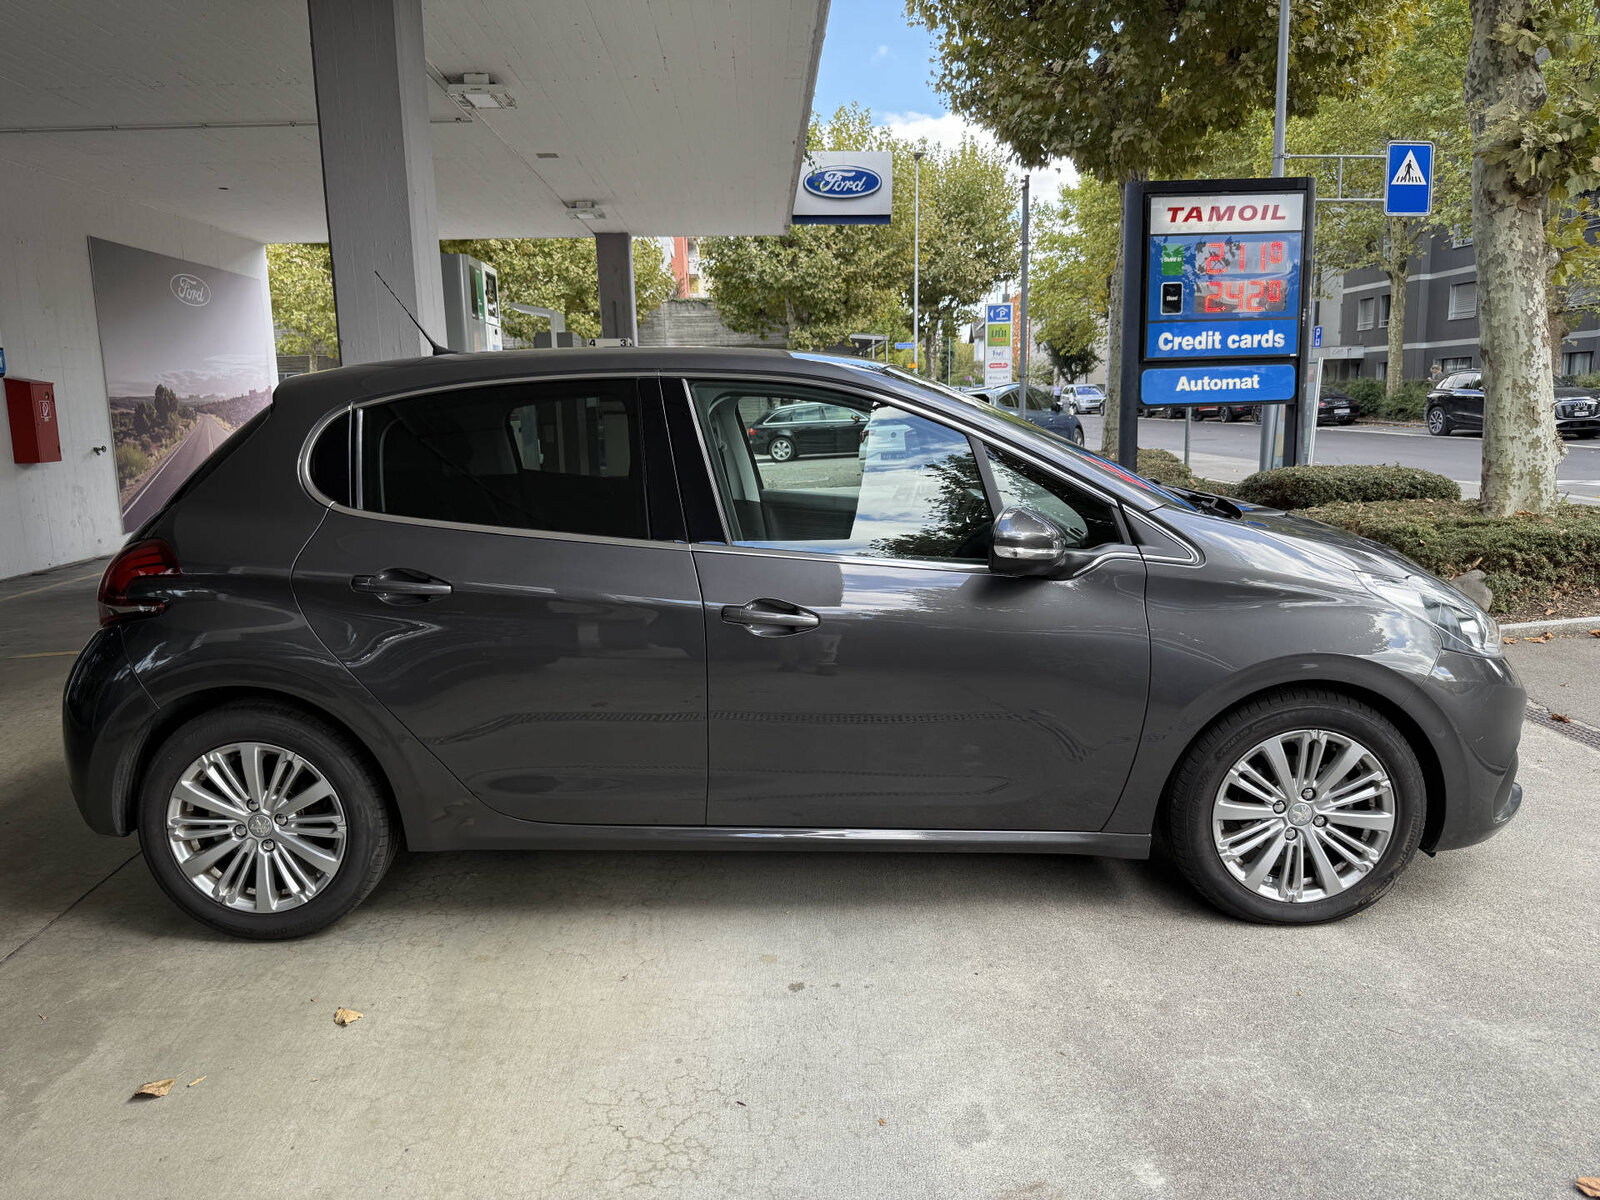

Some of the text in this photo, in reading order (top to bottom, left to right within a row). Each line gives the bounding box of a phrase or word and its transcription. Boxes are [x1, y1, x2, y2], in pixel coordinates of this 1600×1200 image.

[820, 171, 867, 192] Ford
[1167, 204, 1286, 223] TAMOIL
[179, 277, 204, 303] Ford
[589, 339, 596, 347] 4
[620, 339, 627, 347] 3
[1158, 329, 1286, 351] Credit cards
[1176, 374, 1260, 392] Automat
